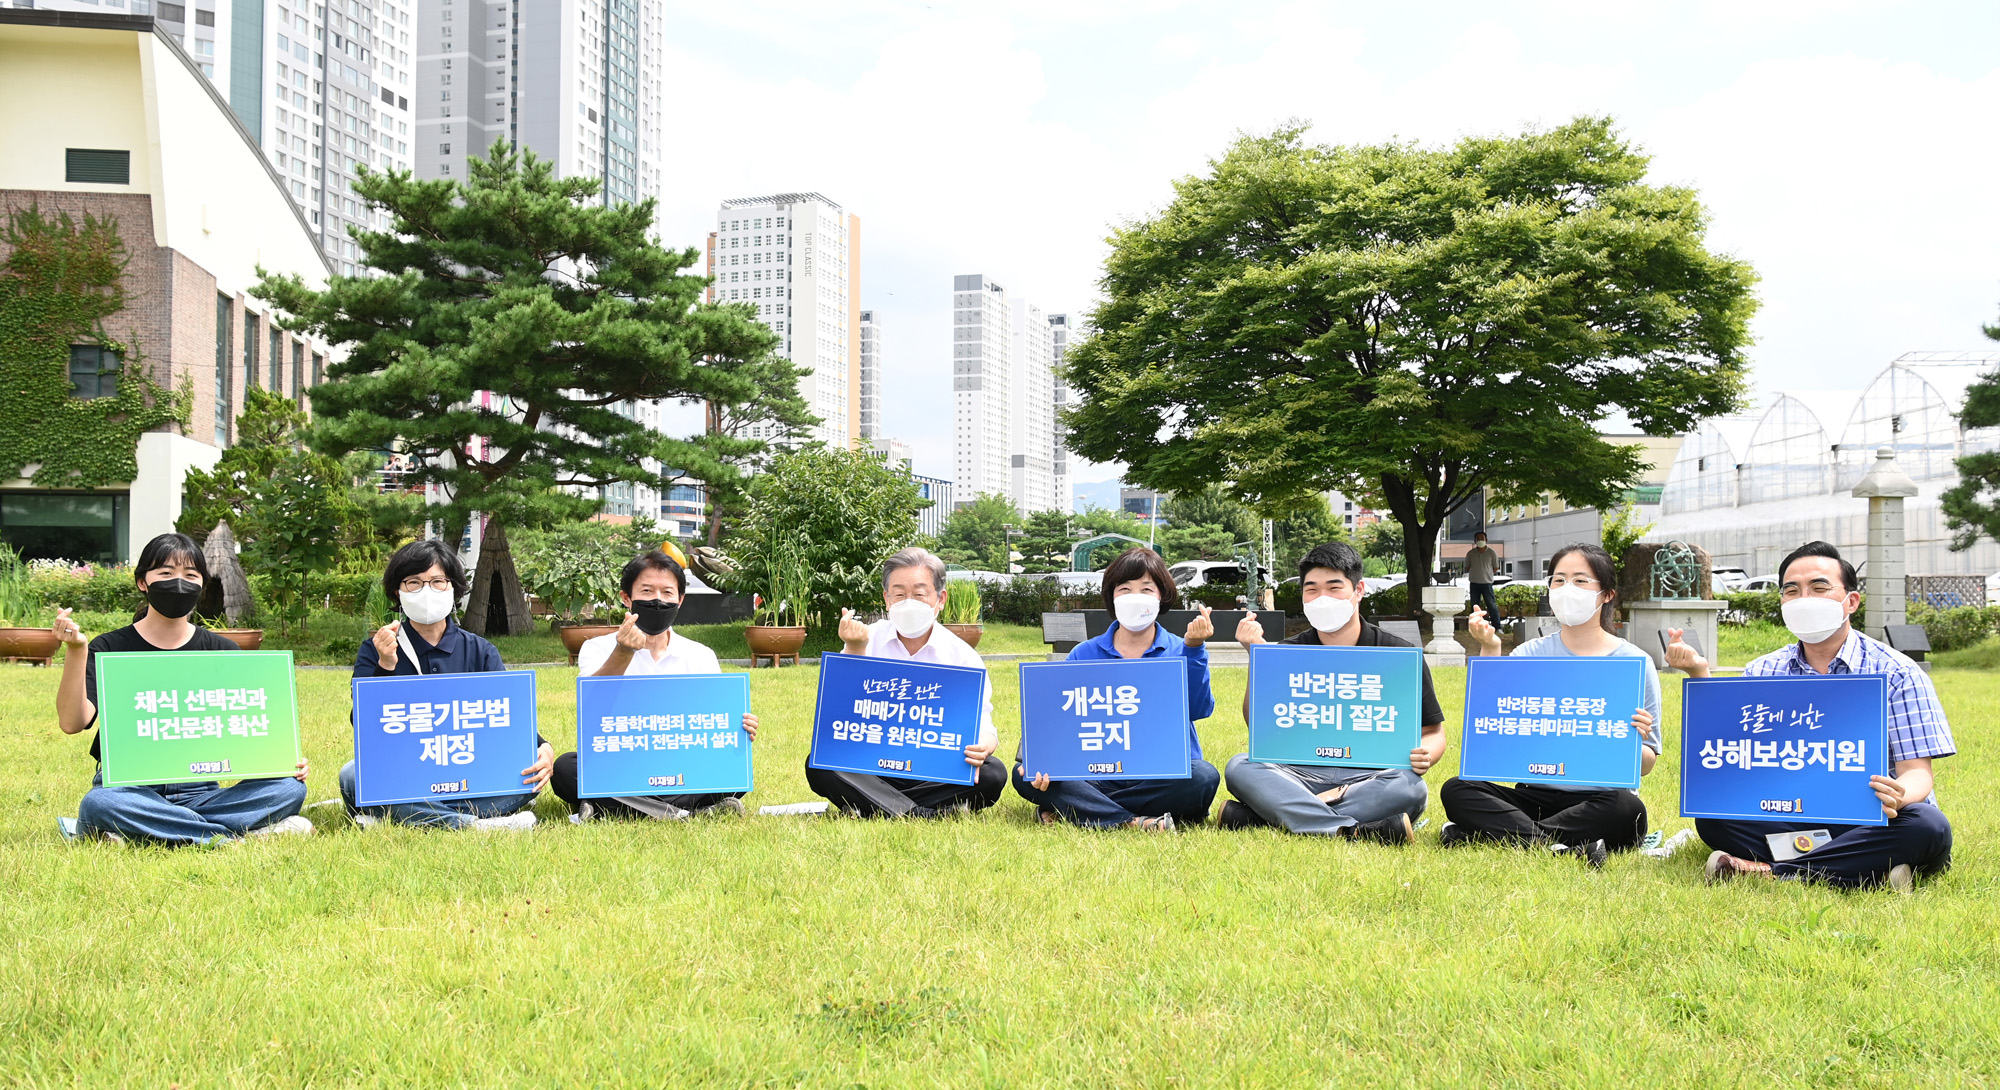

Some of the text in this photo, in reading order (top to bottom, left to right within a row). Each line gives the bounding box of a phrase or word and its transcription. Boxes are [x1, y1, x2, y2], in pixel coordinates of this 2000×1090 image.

[863, 678, 912, 700] 반려동물
[1289, 672, 1384, 701] 반려동물
[134, 688, 268, 714] 채식 선택권과
[854, 698, 944, 726] 매매가 아닌
[1062, 685, 1141, 716] 개식용
[1497, 696, 1607, 716] 반려동물 운동장
[380, 697, 510, 734] 동물기본법
[600, 713, 730, 733] 동물학대범죄 전담팀
[1273, 702, 1398, 732] 양육비 절감
[1739, 703, 1824, 734] 동물에 의한
[136, 714, 270, 741] 비건문화 확산
[832, 720, 962, 751] 입양을 원칙으로!
[1078, 720, 1130, 751] 금지
[1474, 716, 1629, 739] 반려동물테마파크 확충
[420, 732, 475, 766] 제정
[592, 732, 738, 752] 동물복지 전담부서 설치
[1316, 746, 1343, 758] 이재명
[878, 758, 904, 770] 이재명
[1699, 738, 1866, 772] 상해보상지원
[189, 761, 222, 774] 이재명
[1088, 762, 1115, 774] 이재명
[1528, 763, 1557, 776] 이재명
[430, 782, 460, 794] 이재명
[648, 776, 676, 786] 이재명
[1760, 798, 1793, 813] 이재명
